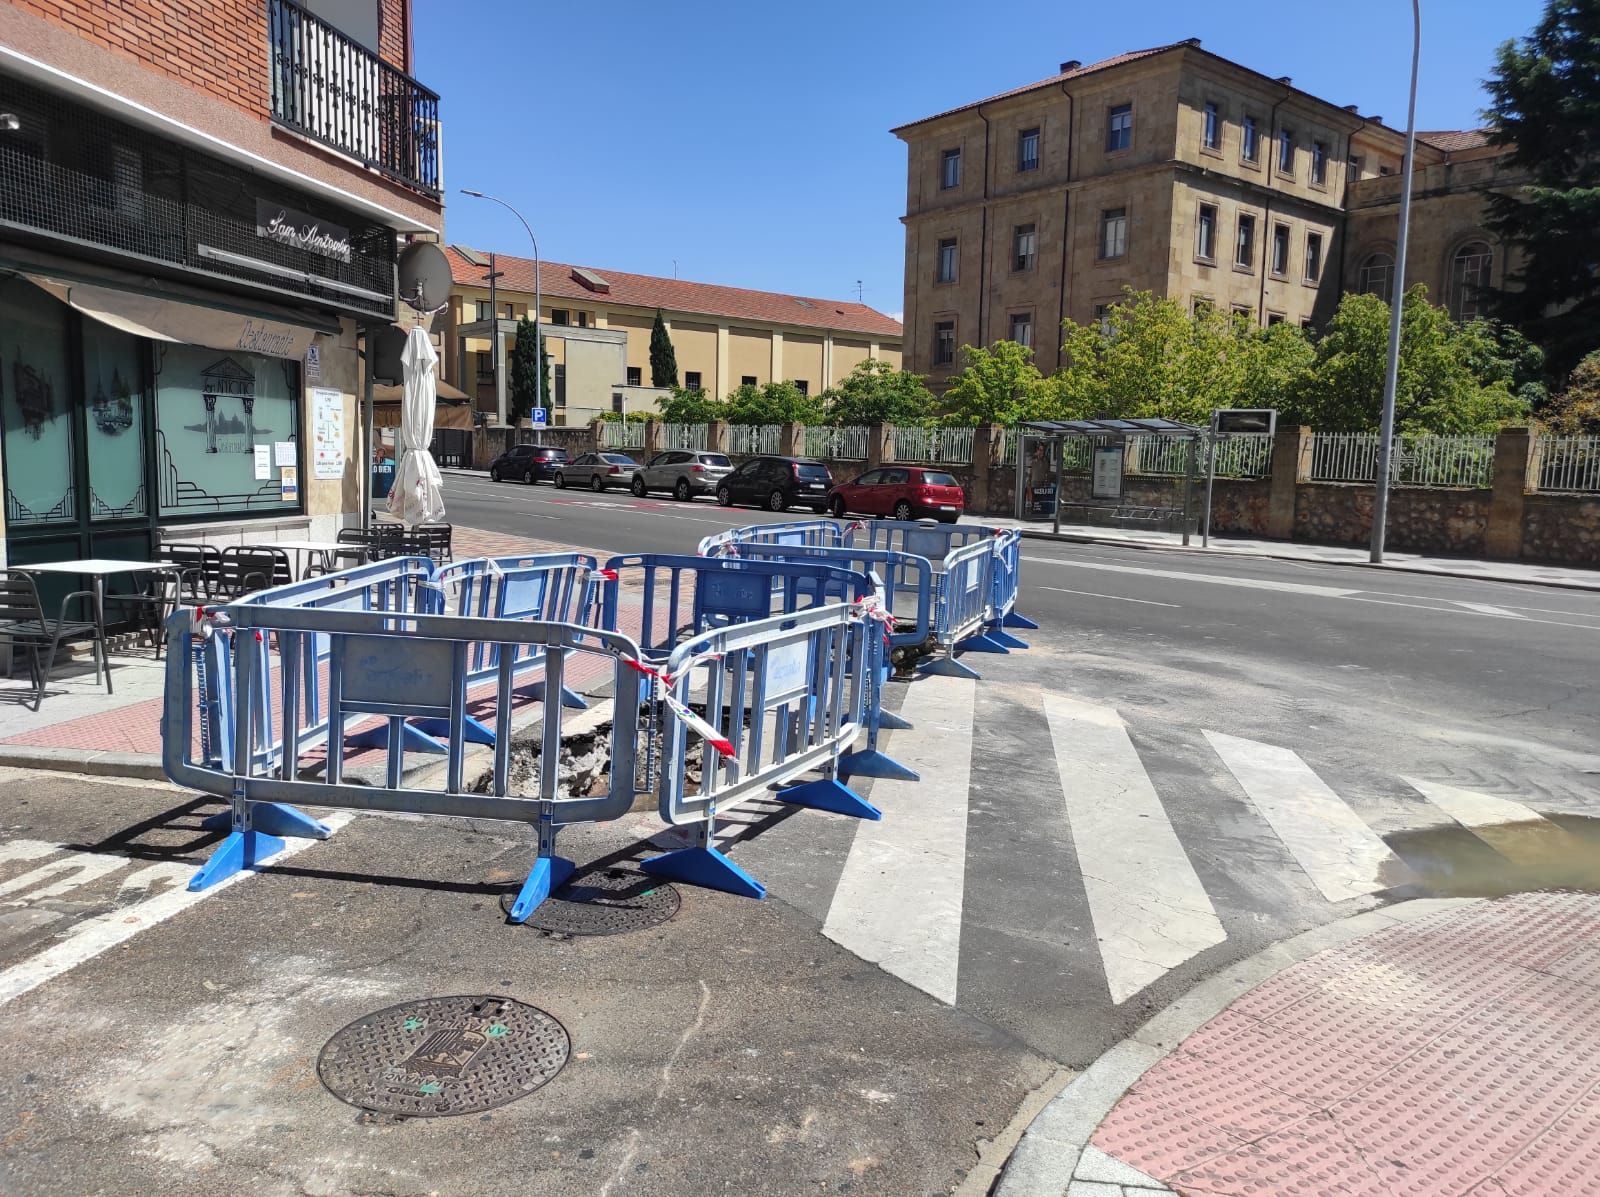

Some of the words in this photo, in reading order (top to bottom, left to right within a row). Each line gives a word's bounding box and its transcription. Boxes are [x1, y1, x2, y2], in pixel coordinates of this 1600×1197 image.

[267, 209, 297, 238] San
[534, 409, 544, 422] P
[376, 1070, 460, 1091] SALAMANCA
